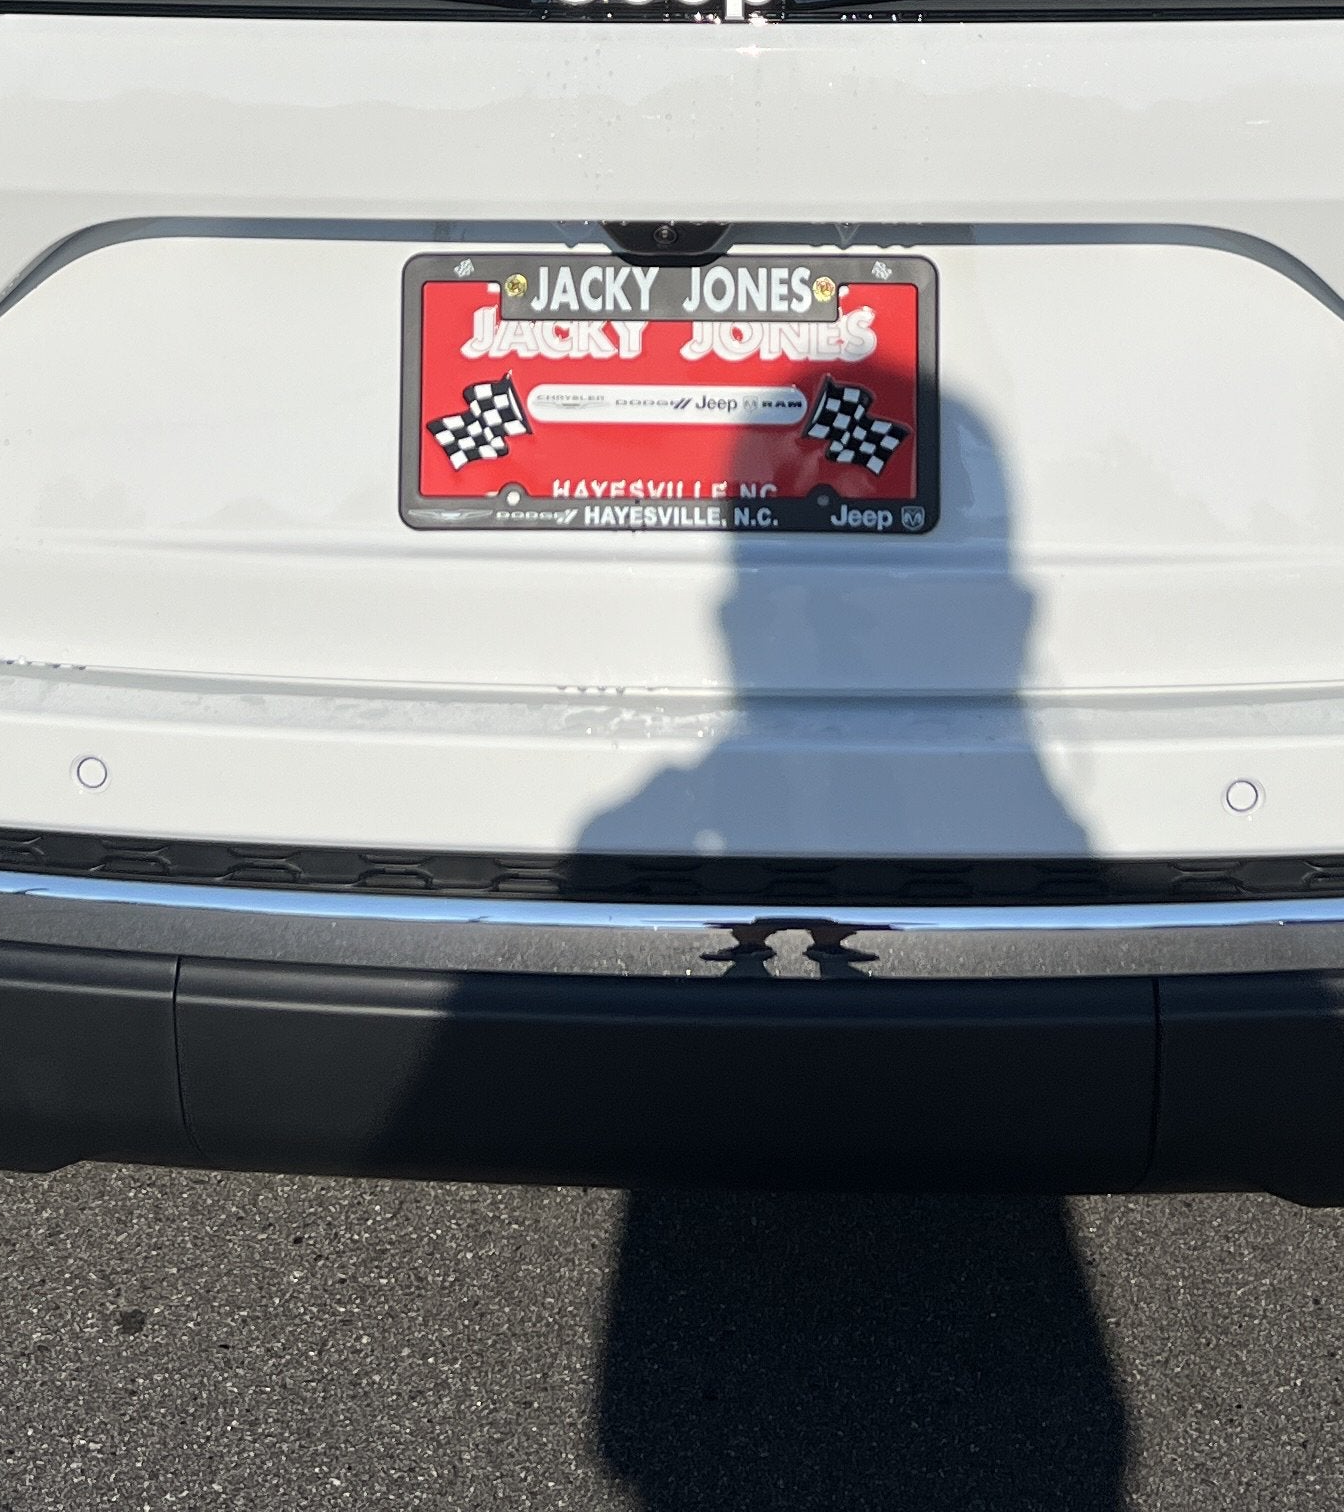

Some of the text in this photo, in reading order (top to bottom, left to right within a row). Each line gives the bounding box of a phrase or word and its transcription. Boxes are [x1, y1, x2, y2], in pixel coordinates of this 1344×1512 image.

[530, 266, 811, 312] JACKY JONES
[460, 306, 877, 362] JACKY JONES
[695, 395, 738, 412] Jeep
[762, 400, 803, 408] RAM
[734, 506, 779, 527] N.C.
[830, 504, 893, 530] Jeep
